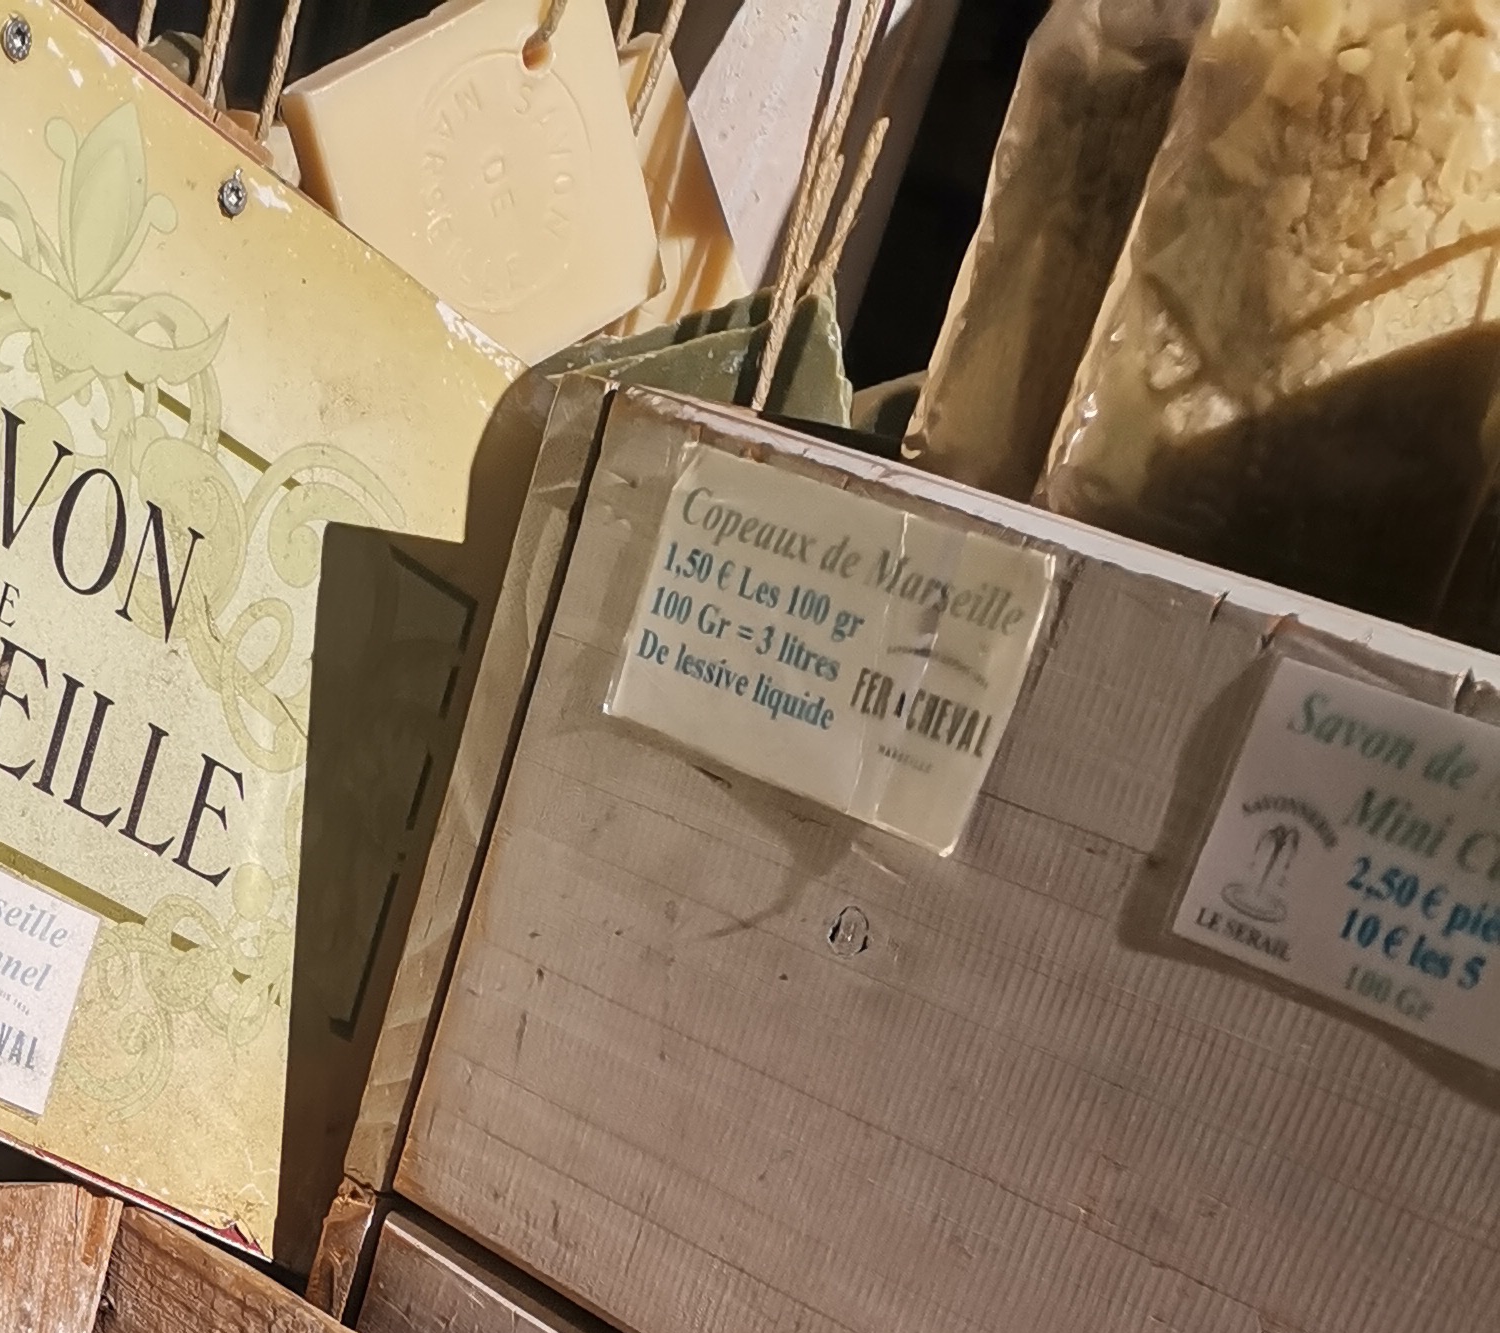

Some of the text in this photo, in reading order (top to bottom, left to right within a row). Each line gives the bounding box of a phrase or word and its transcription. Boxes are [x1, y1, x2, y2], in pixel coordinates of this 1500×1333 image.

[664, 542, 865, 643] 1,50 € Les 100 gr
[682, 487, 1027, 637] Copeaux de Marseille
[636, 628, 836, 731] De lessive liquide
[649, 586, 693, 625] 100
[697, 602, 731, 639] Gr
[755, 627, 775, 657] 3
[776, 636, 841, 682] litres
[850, 667, 894, 720] FER
[906, 688, 992, 758] CHEVAL
[1287, 689, 1478, 790] Savon de
[1343, 788, 1454, 859] Mini
[1340, 907, 1381, 949] 10
[1382, 925, 1409, 959] €
